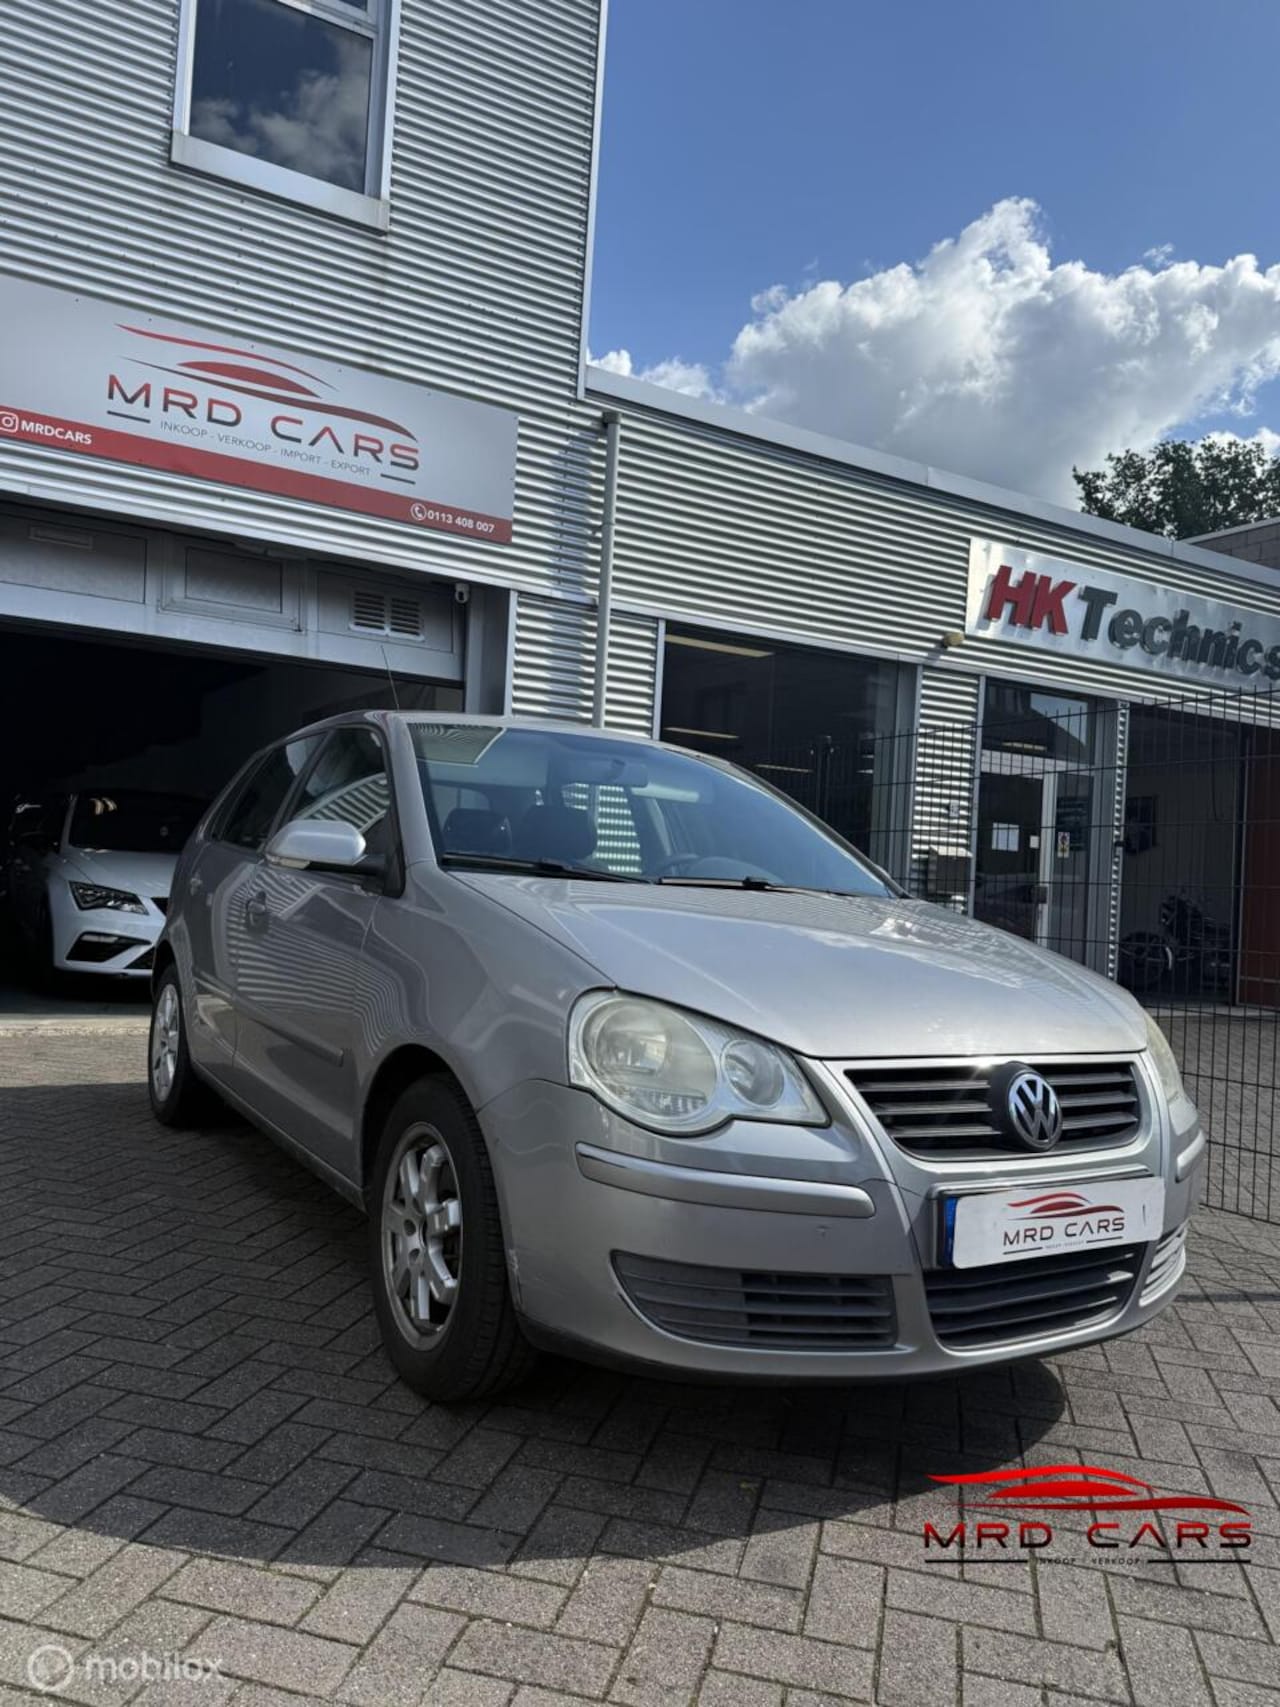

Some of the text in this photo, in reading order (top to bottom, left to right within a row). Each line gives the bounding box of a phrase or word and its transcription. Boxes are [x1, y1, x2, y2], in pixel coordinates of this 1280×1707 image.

[21, 419, 93, 445] MRDCARS
[107, 374, 419, 471] MRD CARS
[160, 421, 208, 438] INKOOP
[217, 433, 272, 452] VERKOOP
[280, 448, 321, 465] IMPORT
[330, 459, 371, 476] EXPORT
[427, 510, 495, 533] 0113 408 007
[1003, 1226, 1054, 1247] MRD
[1064, 1217, 1125, 1238] CARS
